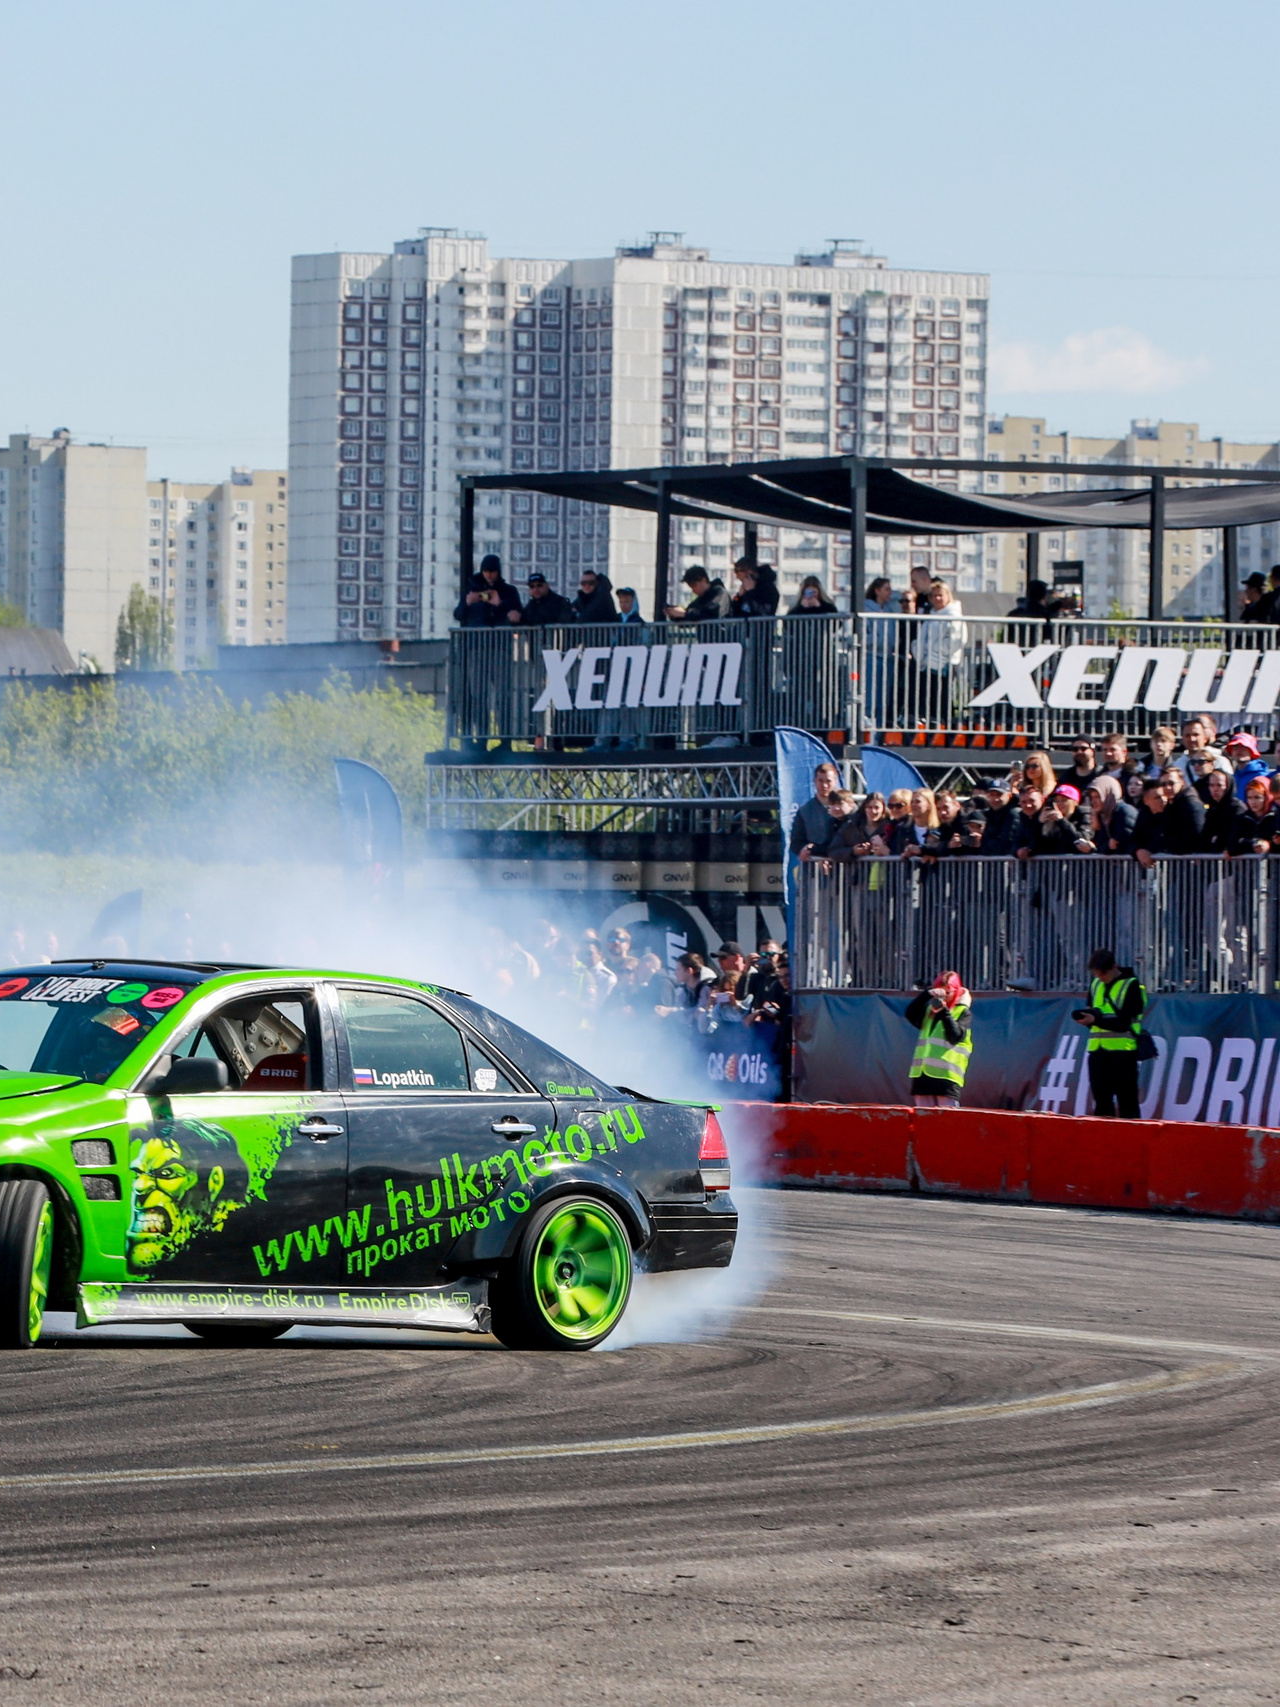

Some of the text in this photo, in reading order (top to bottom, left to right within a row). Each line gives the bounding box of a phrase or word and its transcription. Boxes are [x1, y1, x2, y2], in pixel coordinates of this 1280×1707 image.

[532, 643, 742, 712] XENUM
[259, 1068, 299, 1078] BRIDE
[371, 1069, 435, 1089] Lopatkin
[738, 1052, 768, 1084] Oils
[1039, 1035, 1280, 1127] #ODRI
[253, 1104, 646, 1277] www.hulkmoto.ru
[346, 1221, 444, 1277] прокат
[135, 1287, 453, 1315] www.empire-disk.ru Empire Disk
